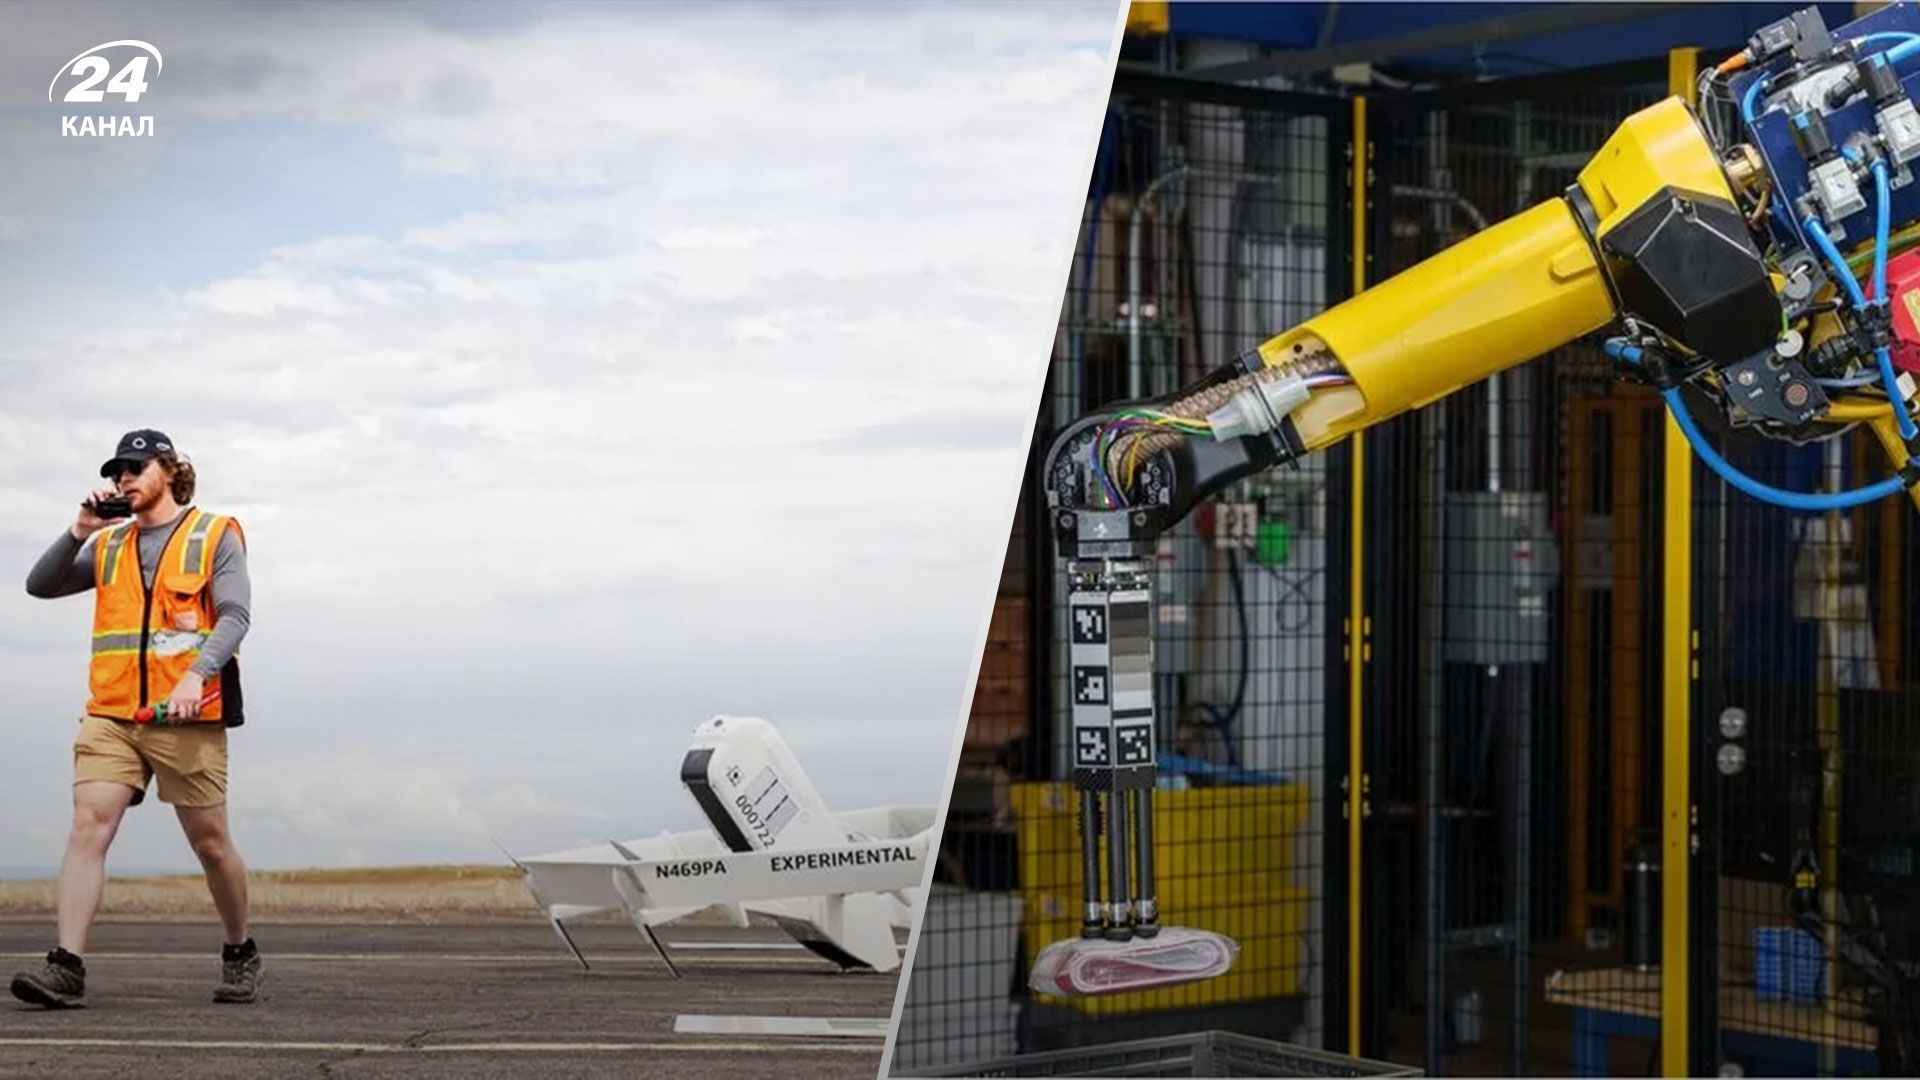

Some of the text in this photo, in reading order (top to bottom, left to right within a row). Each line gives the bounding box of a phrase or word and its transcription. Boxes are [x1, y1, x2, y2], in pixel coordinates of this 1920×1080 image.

[735, 795, 775, 850] 000722
[656, 860, 727, 878] N469PA
[770, 846, 916, 872] EXPERIMENTAL
